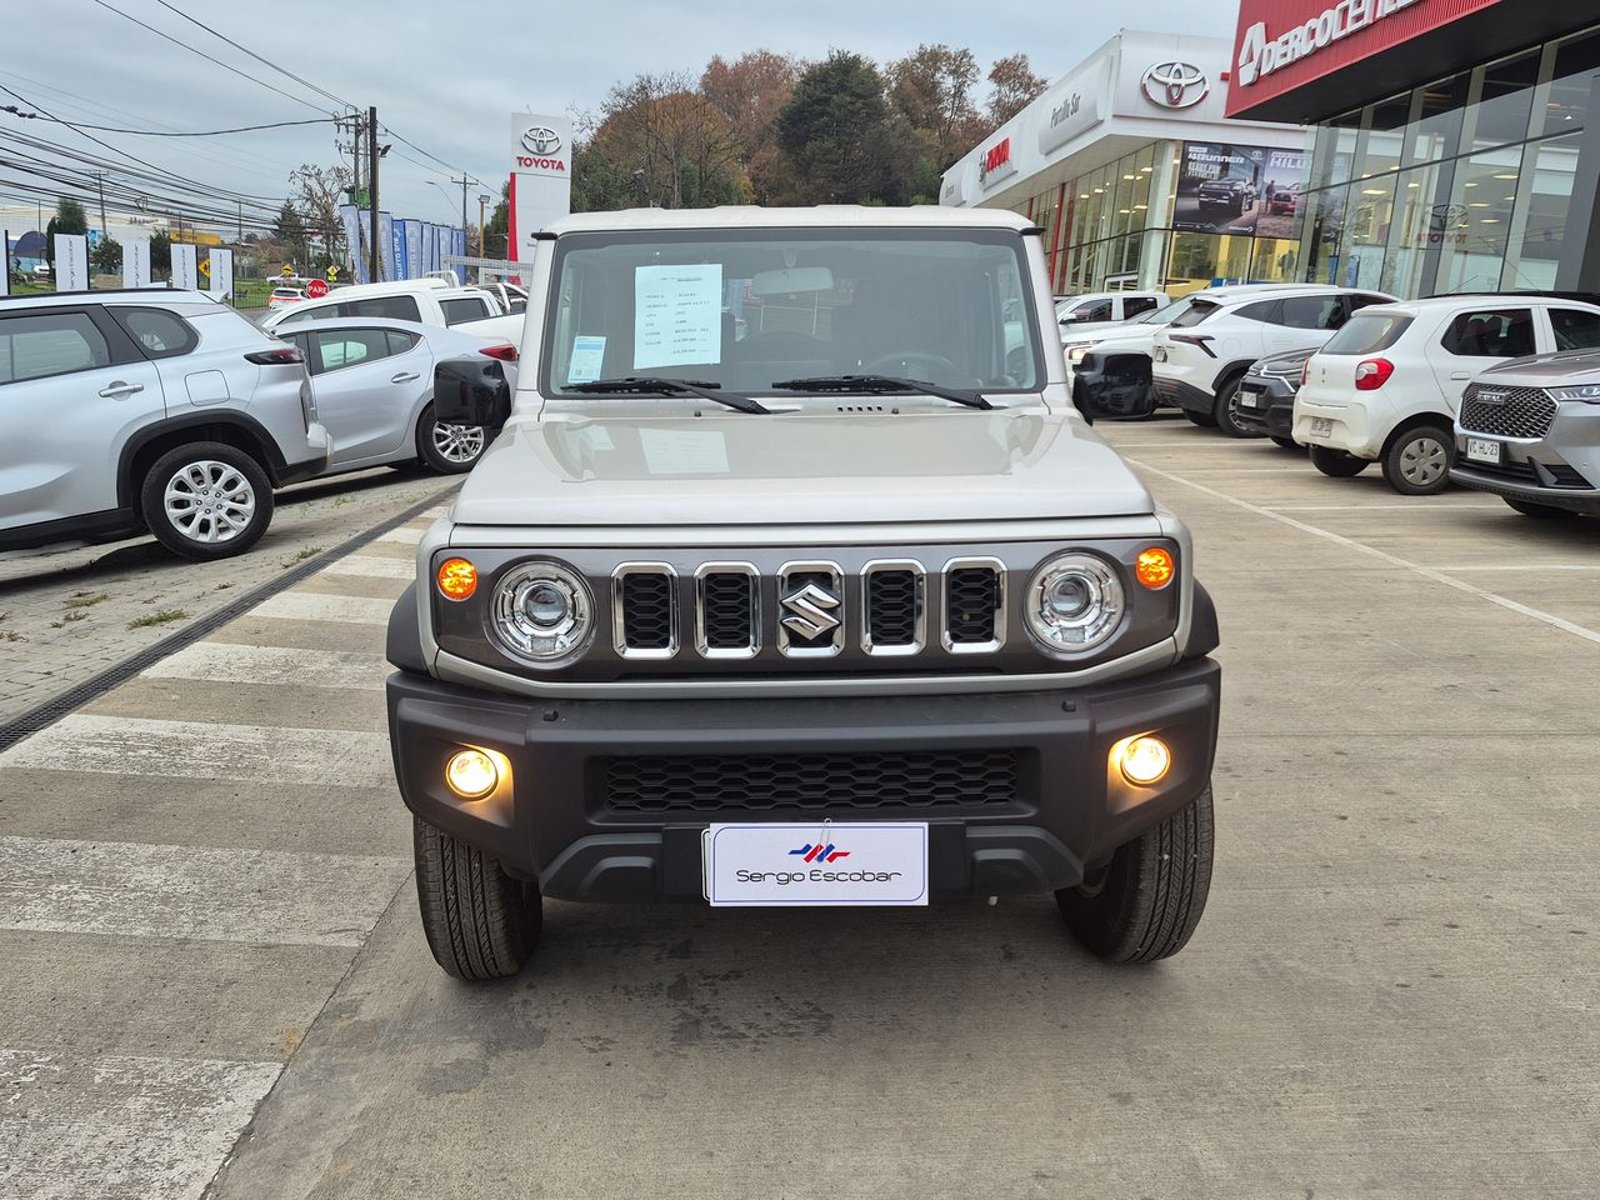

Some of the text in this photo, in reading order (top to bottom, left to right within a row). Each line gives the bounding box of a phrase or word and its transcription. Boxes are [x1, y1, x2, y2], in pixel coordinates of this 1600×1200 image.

[516, 156, 565, 171] TOYOTA
[308, 286, 327, 295] PARE
[736, 869, 902, 885] Sergio Escobar
